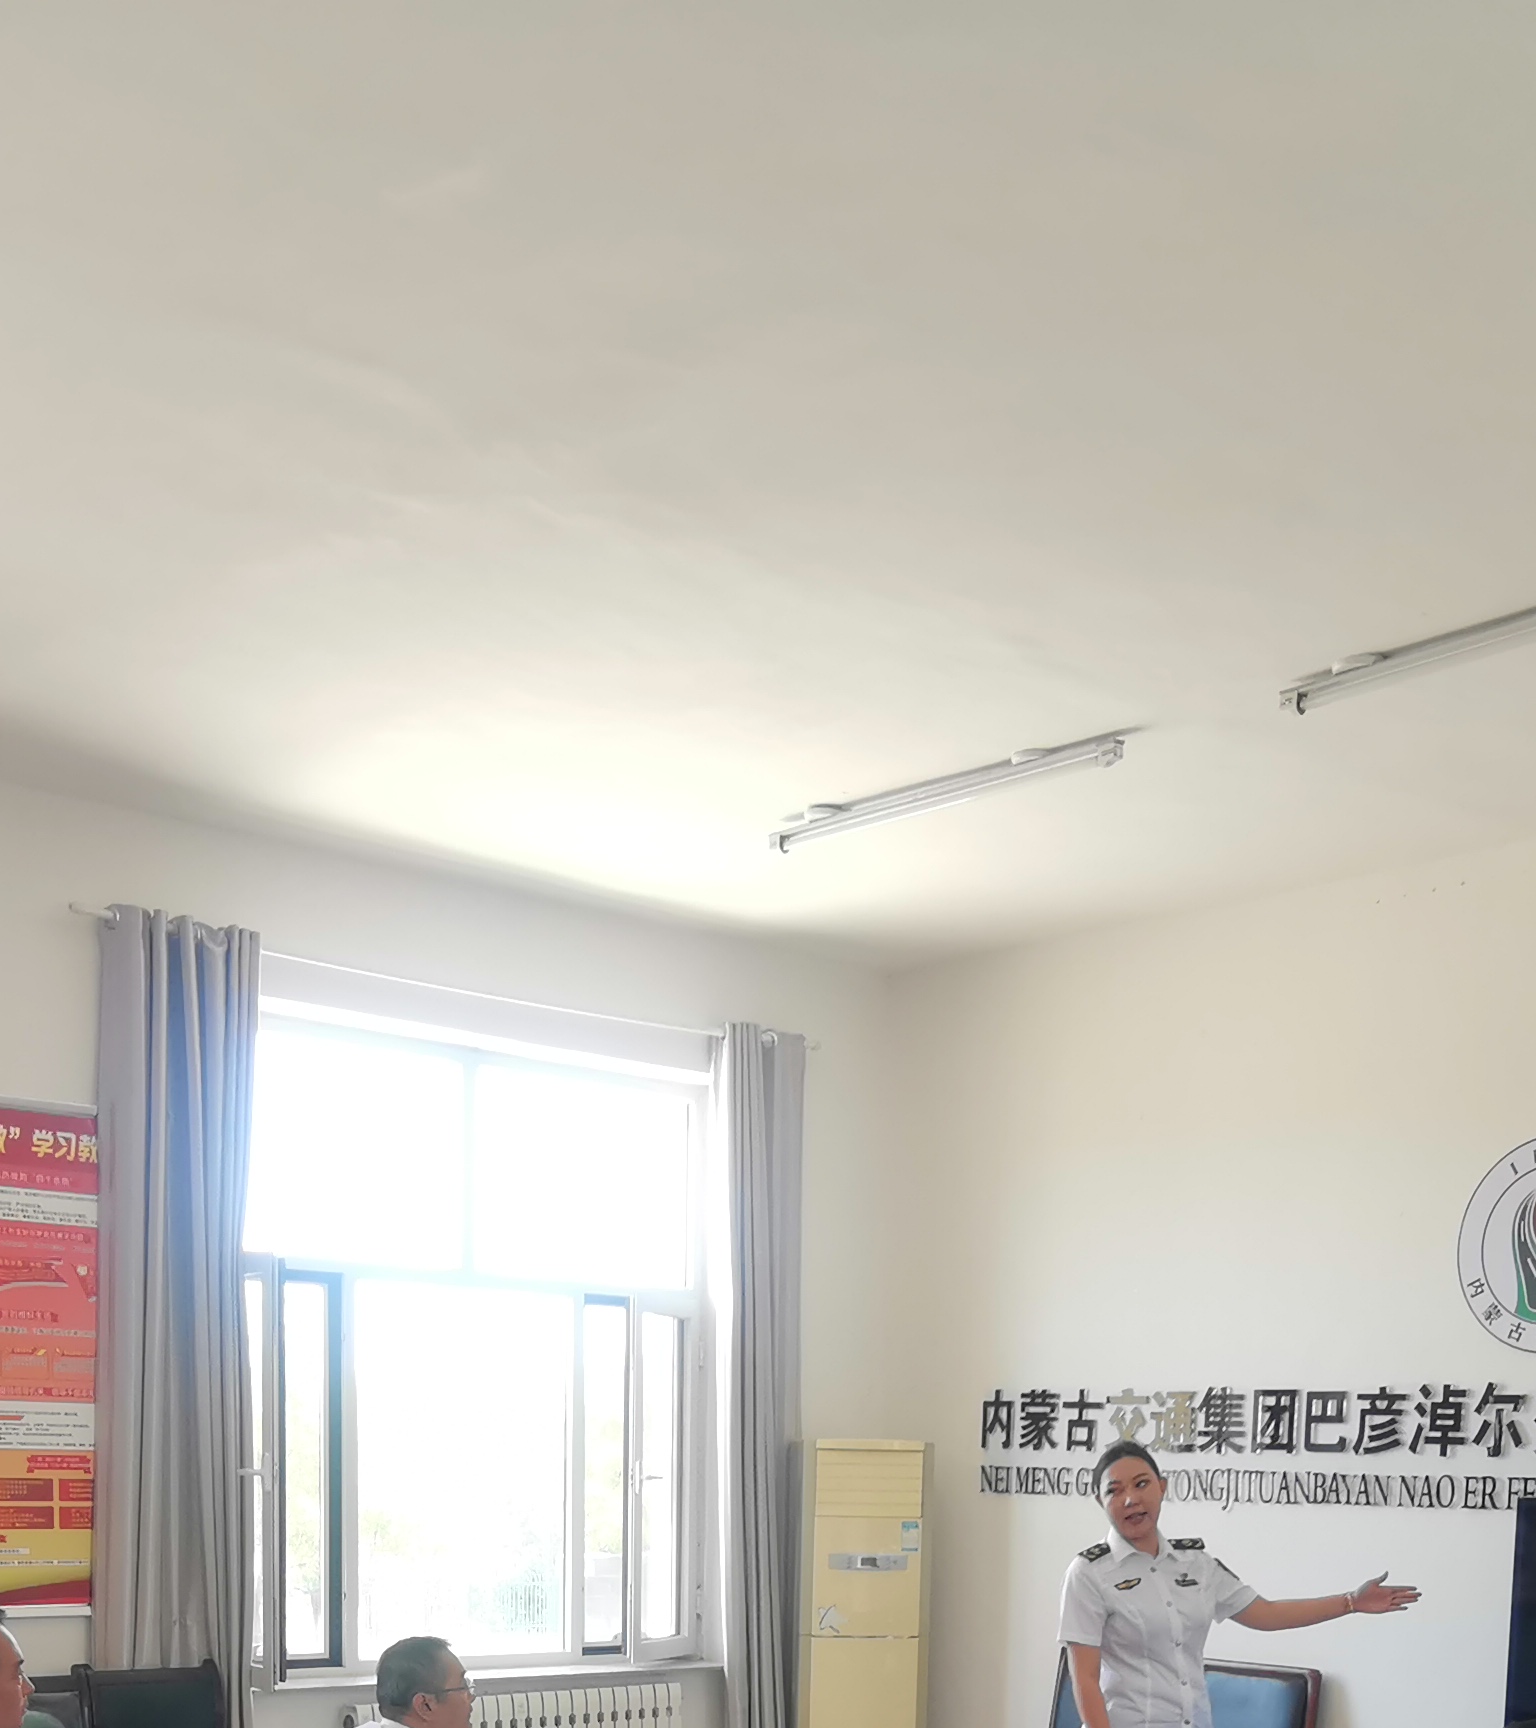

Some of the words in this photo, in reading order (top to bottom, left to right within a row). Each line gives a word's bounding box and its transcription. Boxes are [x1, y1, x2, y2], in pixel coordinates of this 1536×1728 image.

[979, 1465, 1012, 1494] NEI
[1014, 1466, 1071, 1497] MENG
[1075, 1466, 1098, 1497] G
[1398, 1474, 1456, 1509] NAO
[1462, 1475, 1500, 1510] ER
